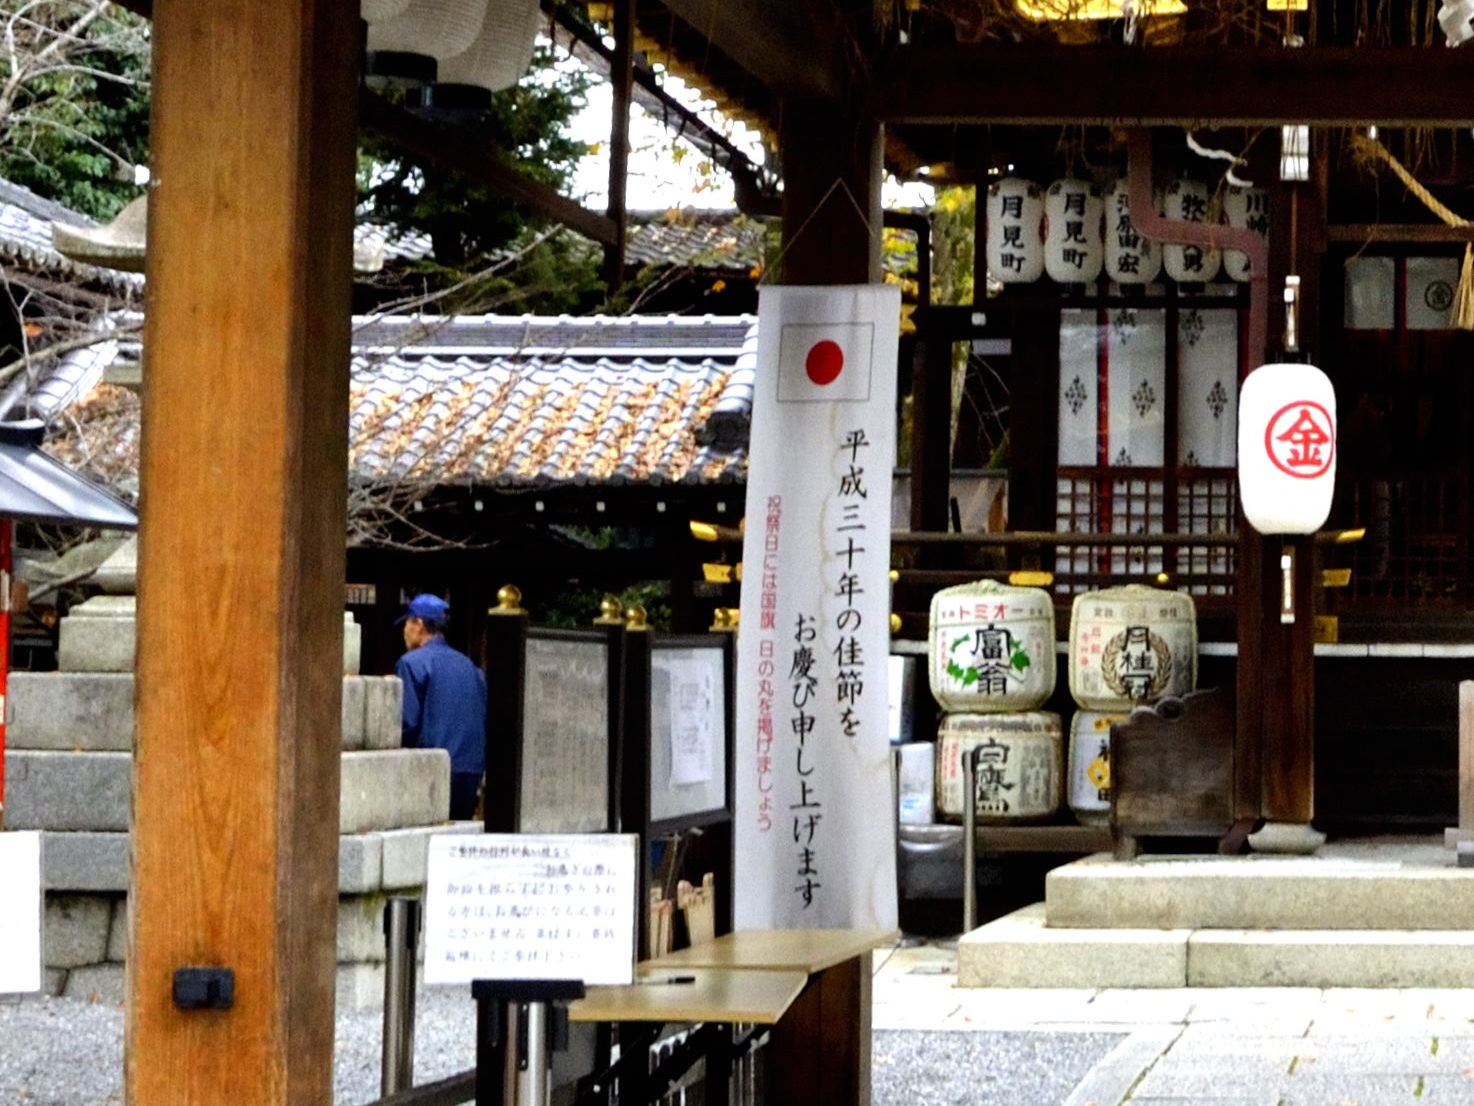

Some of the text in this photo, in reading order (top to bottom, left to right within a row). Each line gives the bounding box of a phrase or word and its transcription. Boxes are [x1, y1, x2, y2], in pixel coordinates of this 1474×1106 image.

[1001, 195, 1026, 273] 月見町
[1062, 193, 1088, 270] 月見町
[1276, 409, 1332, 469] 金
[834, 429, 870, 737] 平成三十年の佳節を
[789, 612, 823, 910] お慶び申し上げます
